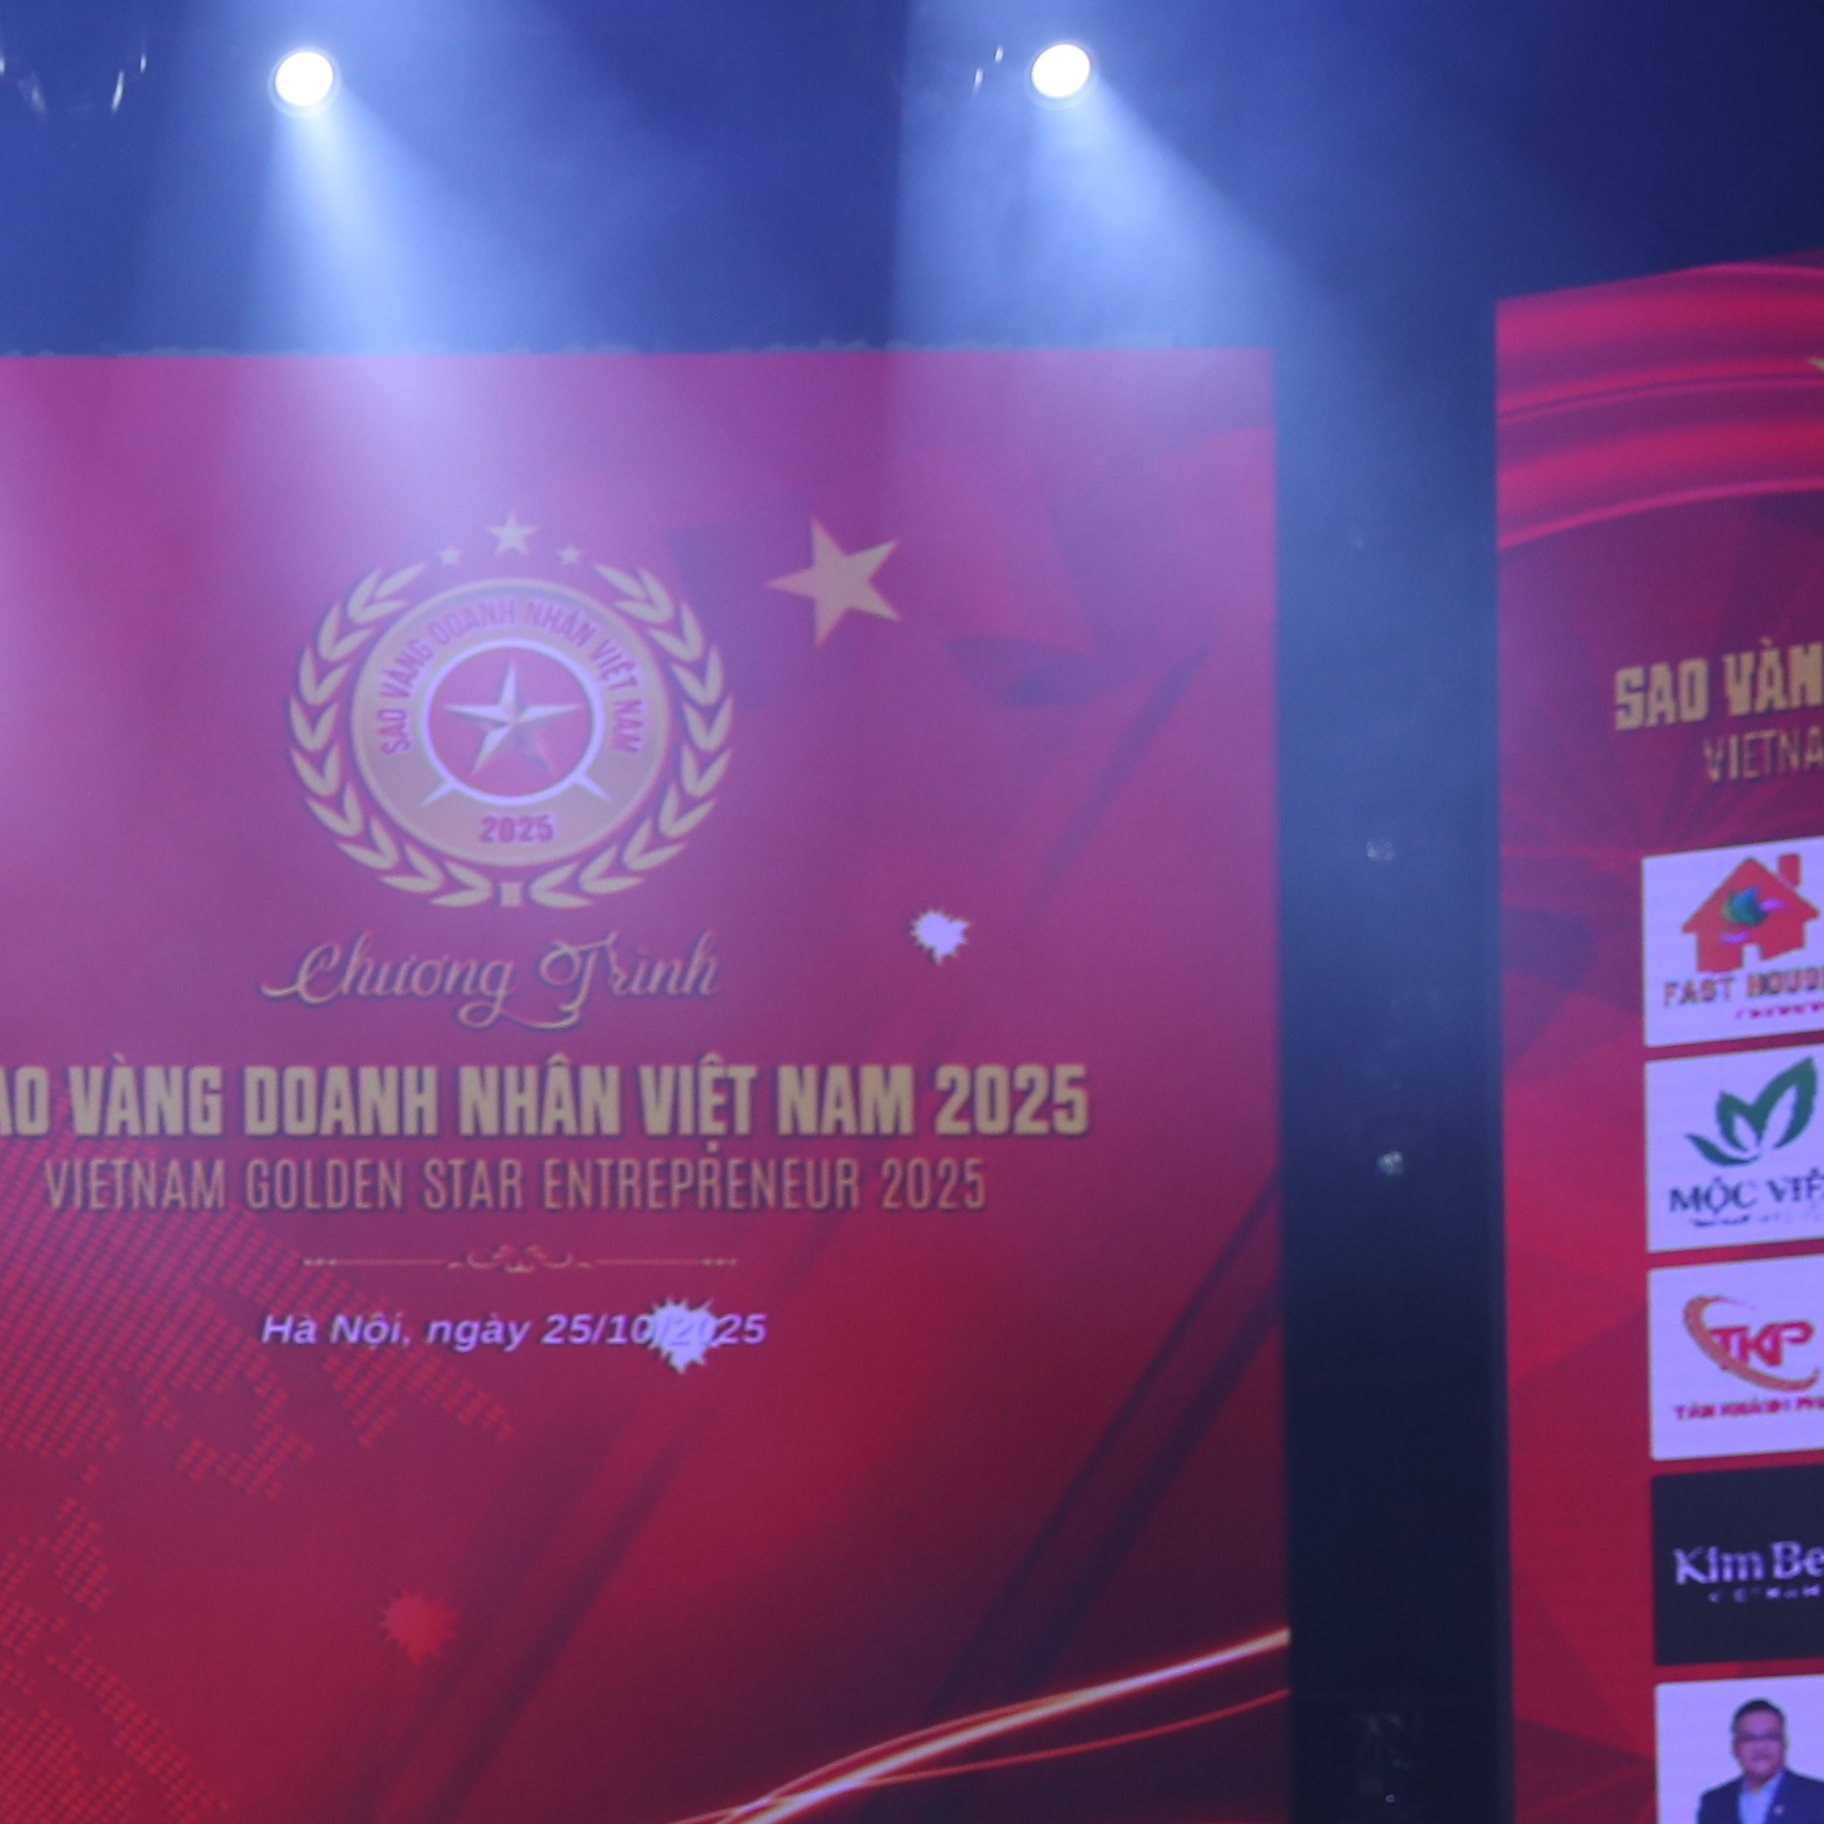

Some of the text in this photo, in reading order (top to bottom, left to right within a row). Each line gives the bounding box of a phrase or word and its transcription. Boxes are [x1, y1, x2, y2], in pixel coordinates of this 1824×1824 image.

[1615, 665, 1708, 731] SAO
[480, 815, 554, 844] 2025
[261, 930, 720, 1028] Chương Trình
[69, 1053, 222, 1136] VÀNG
[244, 1066, 438, 1136] DOANH
[460, 1053, 619, 1136] NHÂN
[639, 1053, 757, 1153] VIỆT
[777, 1064, 915, 1136] NAM
[934, 1064, 1089, 1136] 2025
[45, 1158, 986, 1210] VIETNAM GOLDEN STAR ENTREPRENEUR 2025
[1669, 1176, 1756, 1213] MỘC
[262, 1314, 317, 1344] Hà
[330, 1314, 411, 1352] Nội,
[426, 1313, 531, 1352] ngày
[1673, 1546, 1765, 1585] Kim
